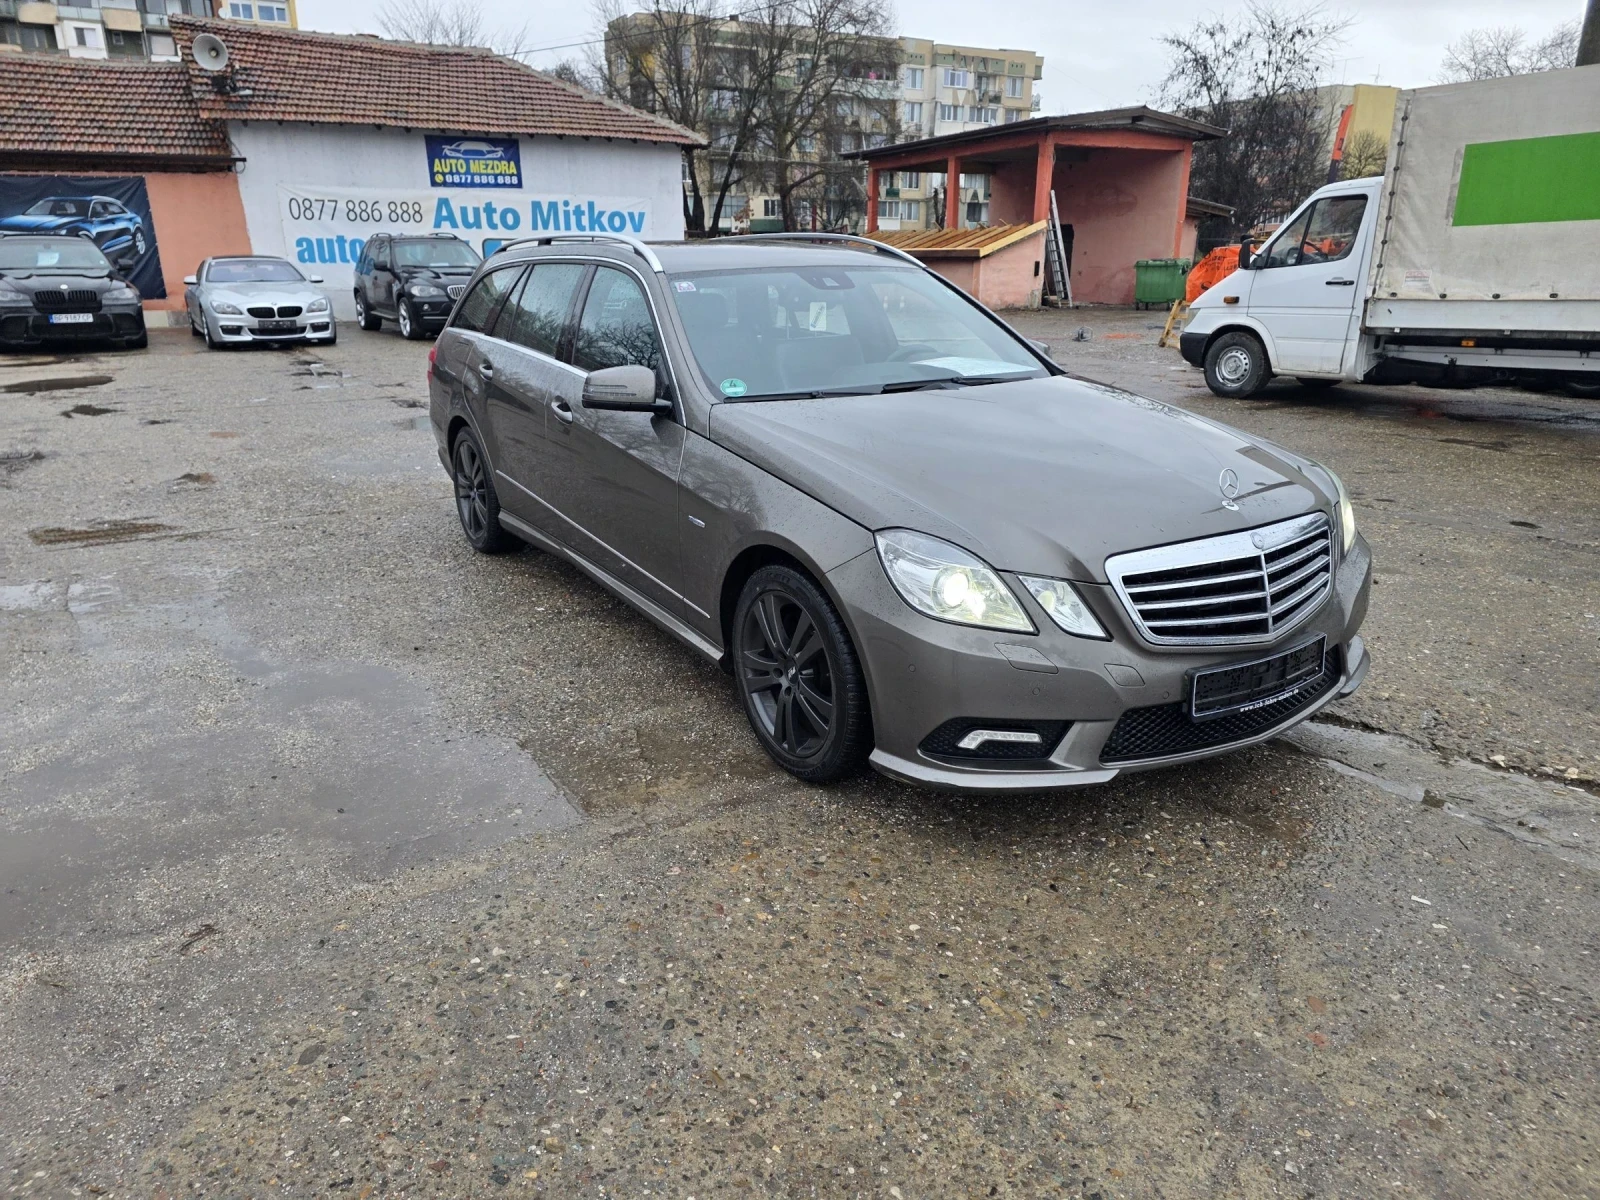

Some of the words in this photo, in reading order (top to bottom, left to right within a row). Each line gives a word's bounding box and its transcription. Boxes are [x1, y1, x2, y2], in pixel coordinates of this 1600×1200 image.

[433, 158, 466, 173] AUTO
[470, 160, 517, 174] MEZDRA
[445, 174, 471, 183] 0877
[473, 175, 495, 184] 886
[497, 175, 518, 185] 888
[289, 197, 338, 221] 0877
[346, 199, 382, 223] 886
[388, 201, 423, 224] 888
[433, 197, 520, 230] Auto
[531, 200, 645, 232] Mitkov
